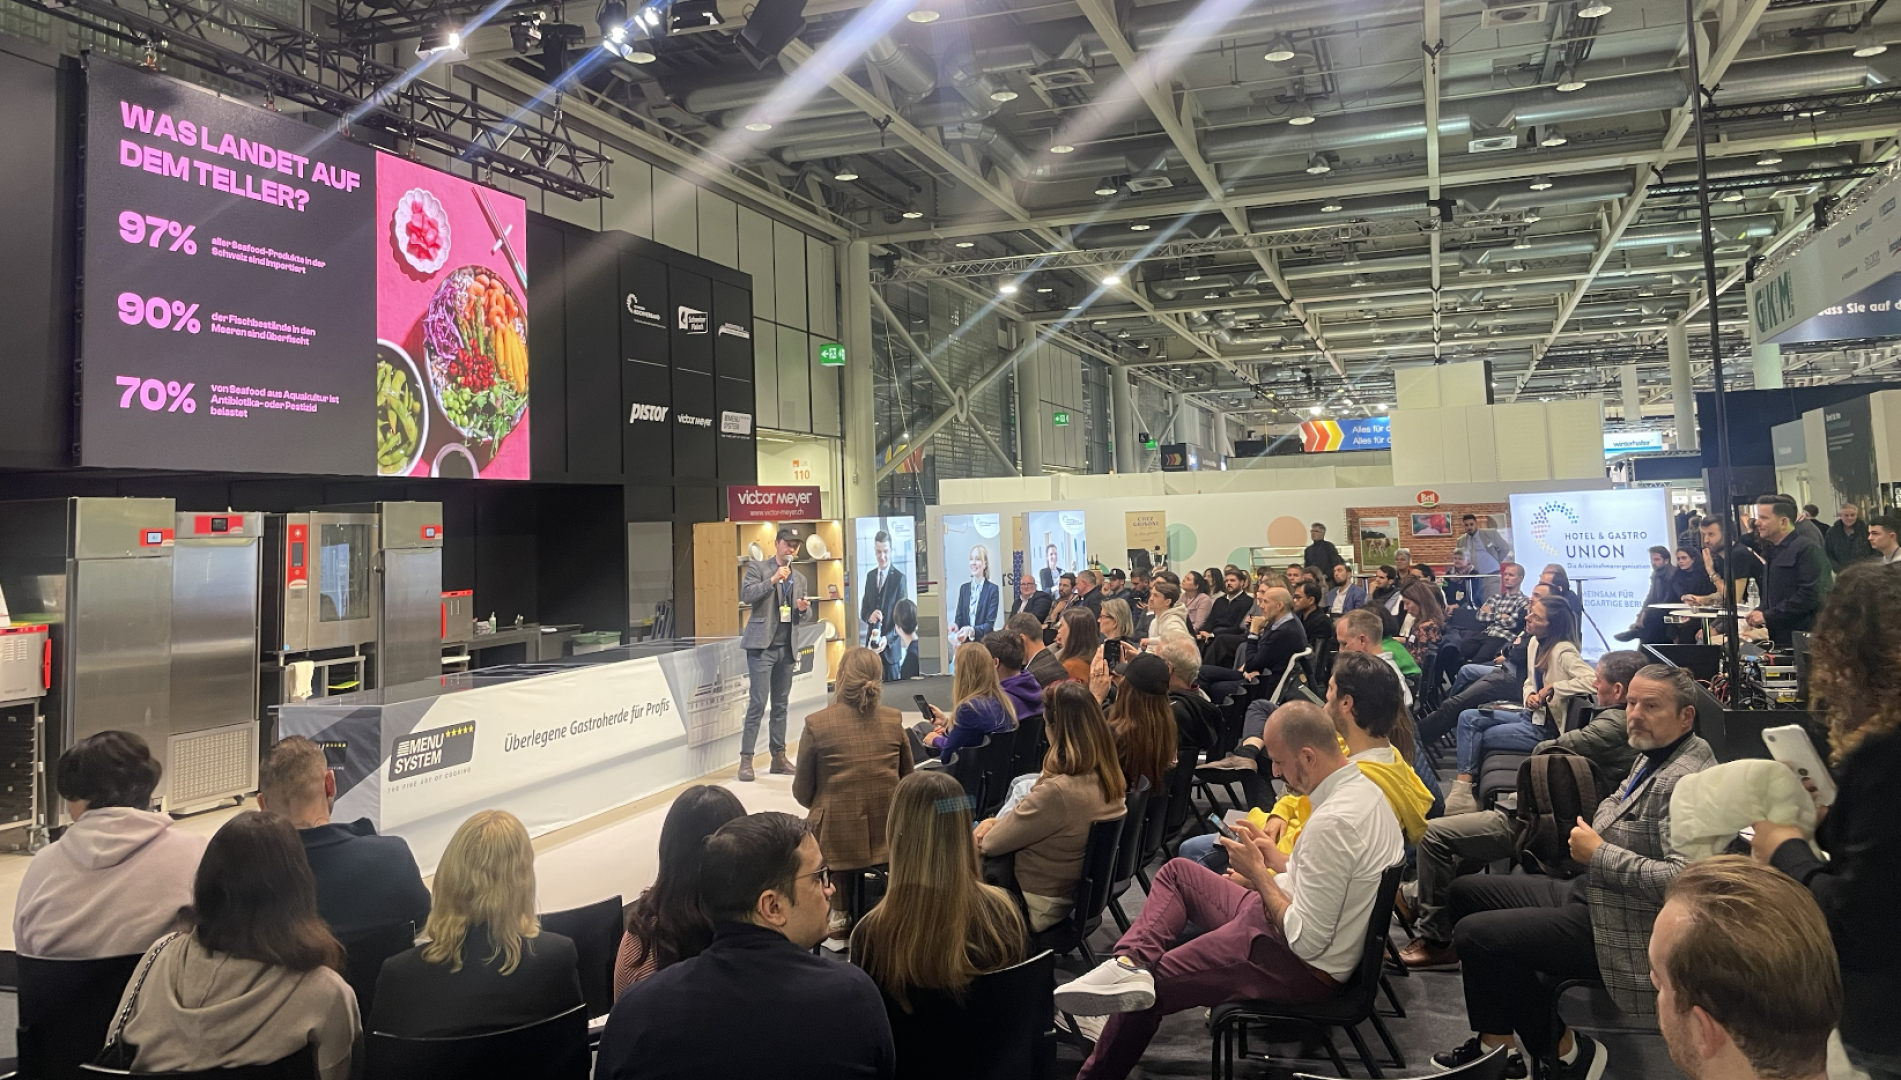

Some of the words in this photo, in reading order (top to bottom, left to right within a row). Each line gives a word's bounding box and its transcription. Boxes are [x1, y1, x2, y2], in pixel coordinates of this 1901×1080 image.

[120, 101, 198, 147] WAS
[201, 126, 309, 179] LANDET
[311, 161, 361, 193] AUF
[119, 139, 190, 182] DEM
[193, 159, 311, 212] TELLER?
[118, 210, 198, 256] 97%
[211, 237, 231, 248] aller
[305, 256, 312, 266] in
[211, 246, 248, 262] Schweiz
[248, 255, 266, 266] sind
[117, 291, 201, 334] 90%
[1847, 302, 1866, 314] Sie
[1869, 300, 1891, 312] auf
[211, 312, 228, 322] der
[228, 313, 292, 333] Fischbestände
[292, 324, 300, 334] in
[300, 325, 316, 336] den
[211, 322, 247, 337] Meeren
[247, 329, 266, 340] sind
[116, 375, 197, 414] 70%
[210, 384, 229, 393] von
[229, 384, 266, 397] Seafood
[266, 390, 283, 399] aus
[283, 390, 329, 403] Aquakultur
[329, 394, 340, 404] ist
[210, 405, 248, 418] belastet
[264, 399, 285, 409] oder
[285, 401, 318, 413] Pestizid
[1352, 425, 1371, 434] Alles
[1373, 424, 1384, 433] für
[1352, 436, 1372, 445] Alles
[1373, 435, 1385, 444] für
[794, 469, 811, 481] 110
[750, 507, 804, 517] www.victor-meyer.ch
[1565, 532, 1595, 540] HOTEL
[1598, 532, 1605, 540] &
[1608, 531, 1648, 540] GASTRO
[1566, 544, 1625, 559] UNION
[1583, 600, 1623, 608] ZIGARTIGE
[1618, 589, 1634, 599] FÜR
[504, 725, 568, 753] Überlegene
[569, 708, 629, 736] Gastroherde
[629, 704, 645, 725] für
[645, 697, 671, 717] Profis
[409, 732, 445, 755] MENU
[394, 748, 443, 775] SYSTEM
[387, 785, 400, 794] THE
[402, 781, 418, 790] FINE
[420, 776, 433, 785] ART
[434, 774, 443, 782] OF
[444, 766, 472, 779] COOKING
